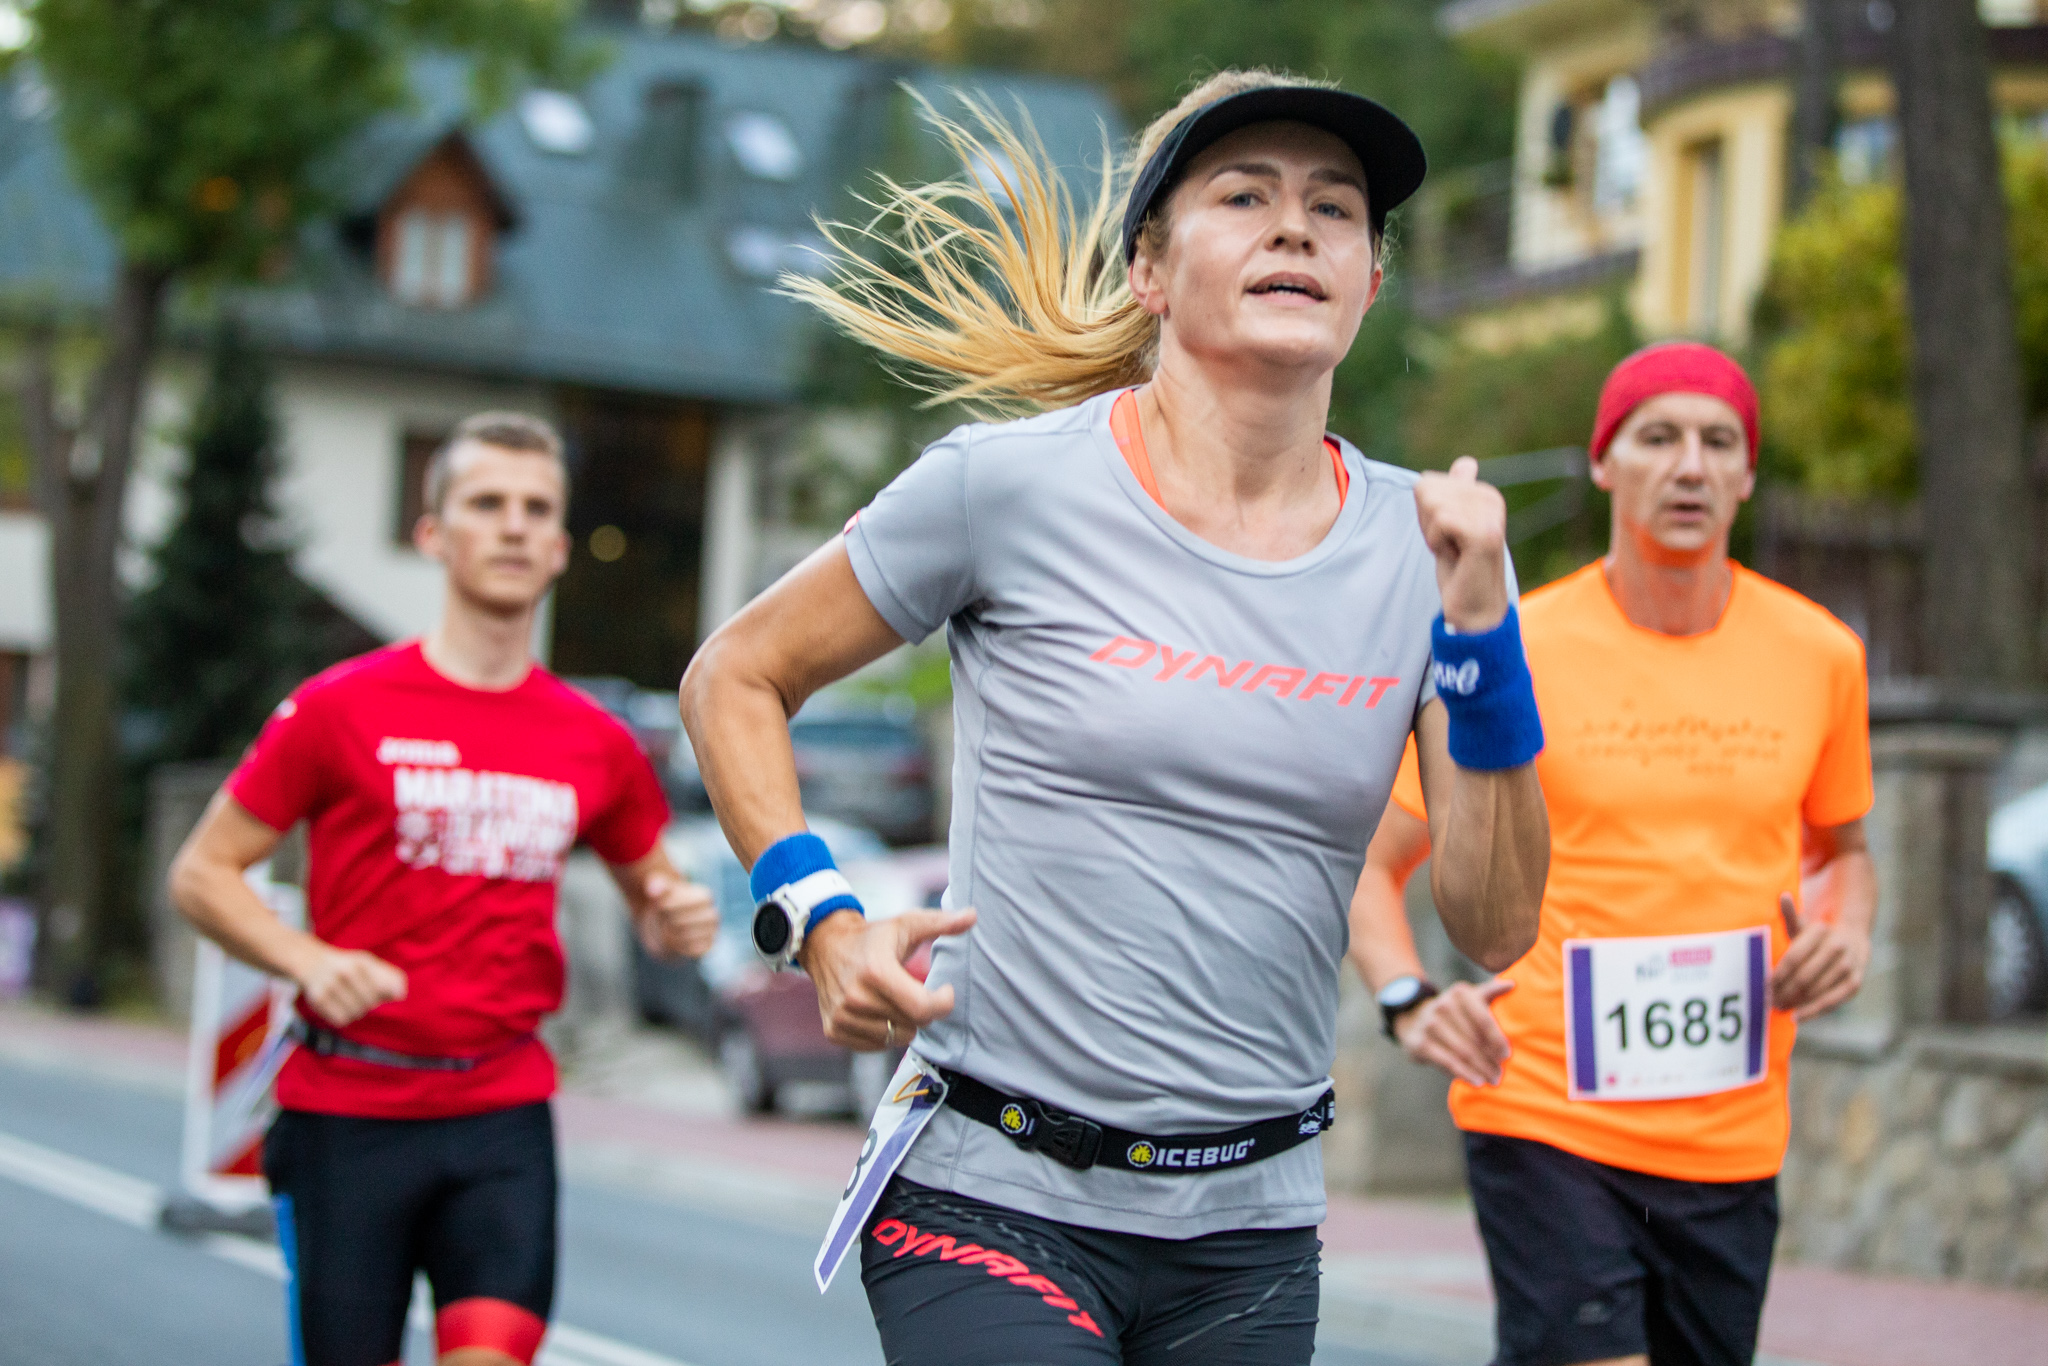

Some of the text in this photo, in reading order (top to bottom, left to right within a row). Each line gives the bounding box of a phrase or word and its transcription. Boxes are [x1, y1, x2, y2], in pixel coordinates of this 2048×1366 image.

[1088, 635, 1401, 709] DYNAFIT
[1606, 993, 1742, 1050] 1685
[871, 1217, 1105, 1338] DYNAFIT
